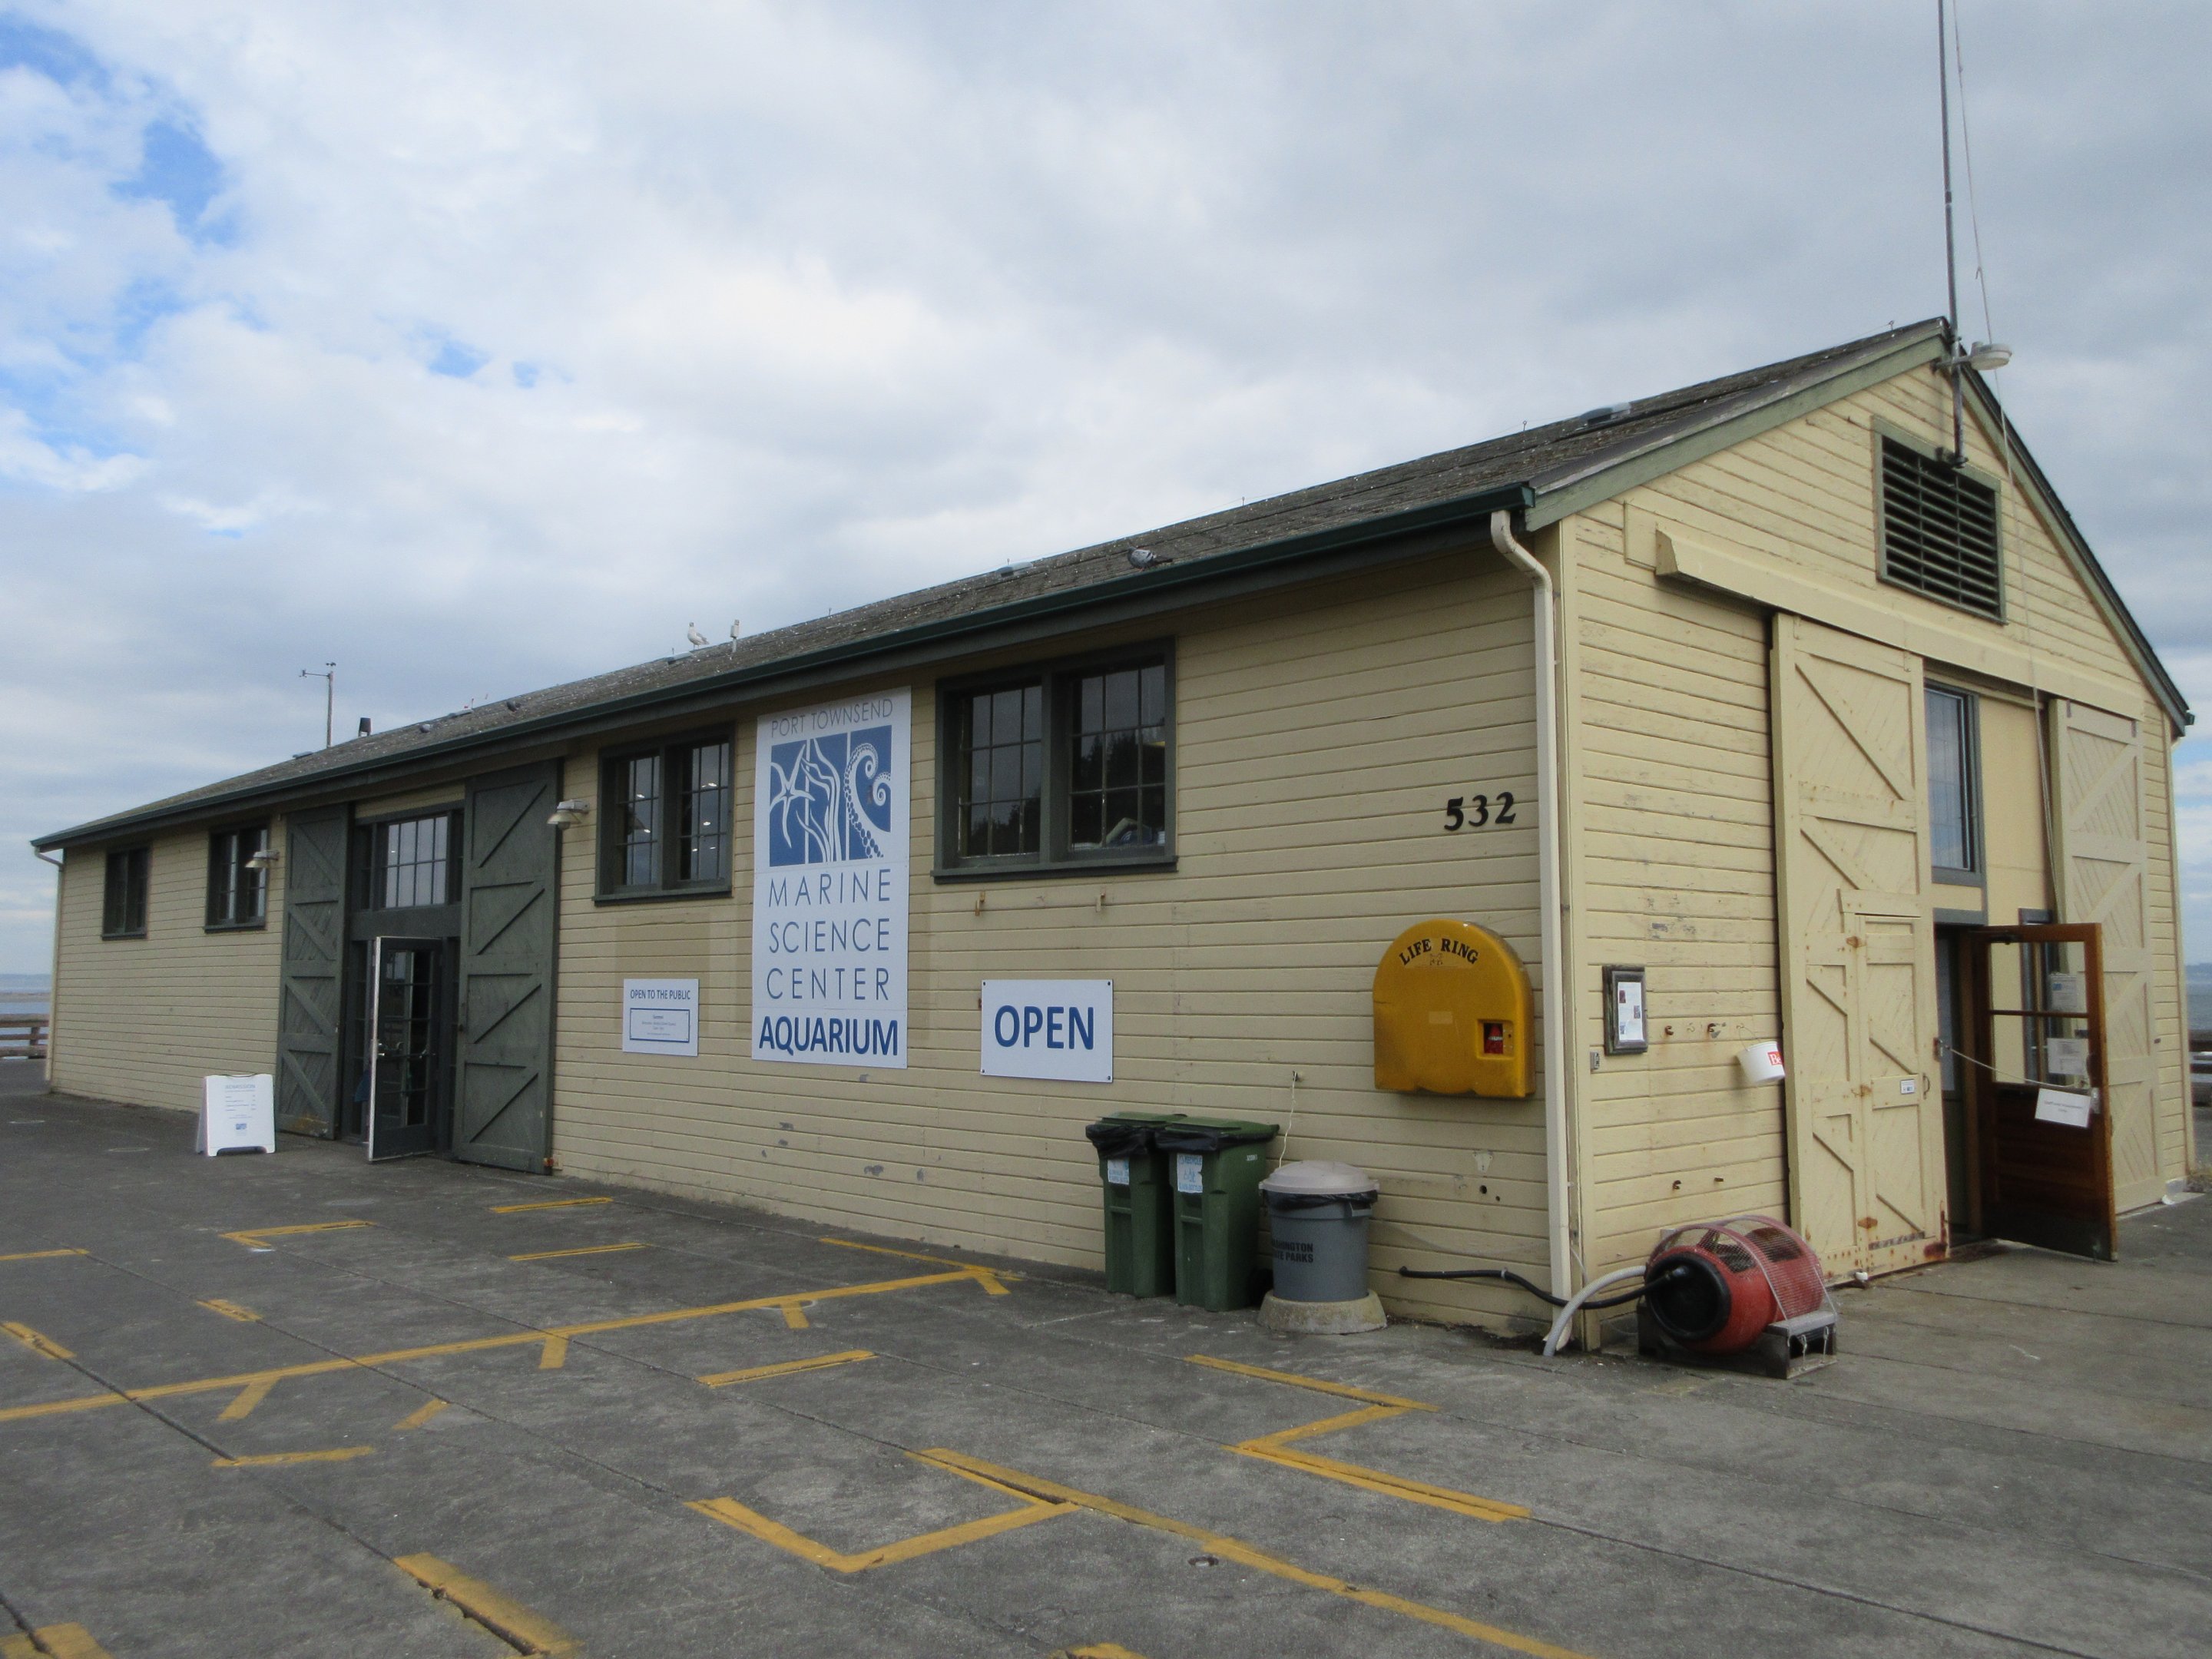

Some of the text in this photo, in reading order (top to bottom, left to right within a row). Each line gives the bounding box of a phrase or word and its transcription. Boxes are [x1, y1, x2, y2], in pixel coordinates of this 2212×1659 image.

[771, 698, 893, 738] PORT TOWNSEND
[1443, 791, 1517, 832] 532
[768, 868, 892, 907] MARINE
[769, 918, 890, 953] SCIENCE
[1399, 938, 1479, 965] LIFE RING
[631, 989, 690, 1000] OPEN TO THE PUBLIC
[767, 967, 889, 1001] CENTER
[759, 1015, 898, 1057] AQUARIUM
[994, 1005, 1094, 1051] OPEN
[1286, 1252, 1313, 1263] PARKS
